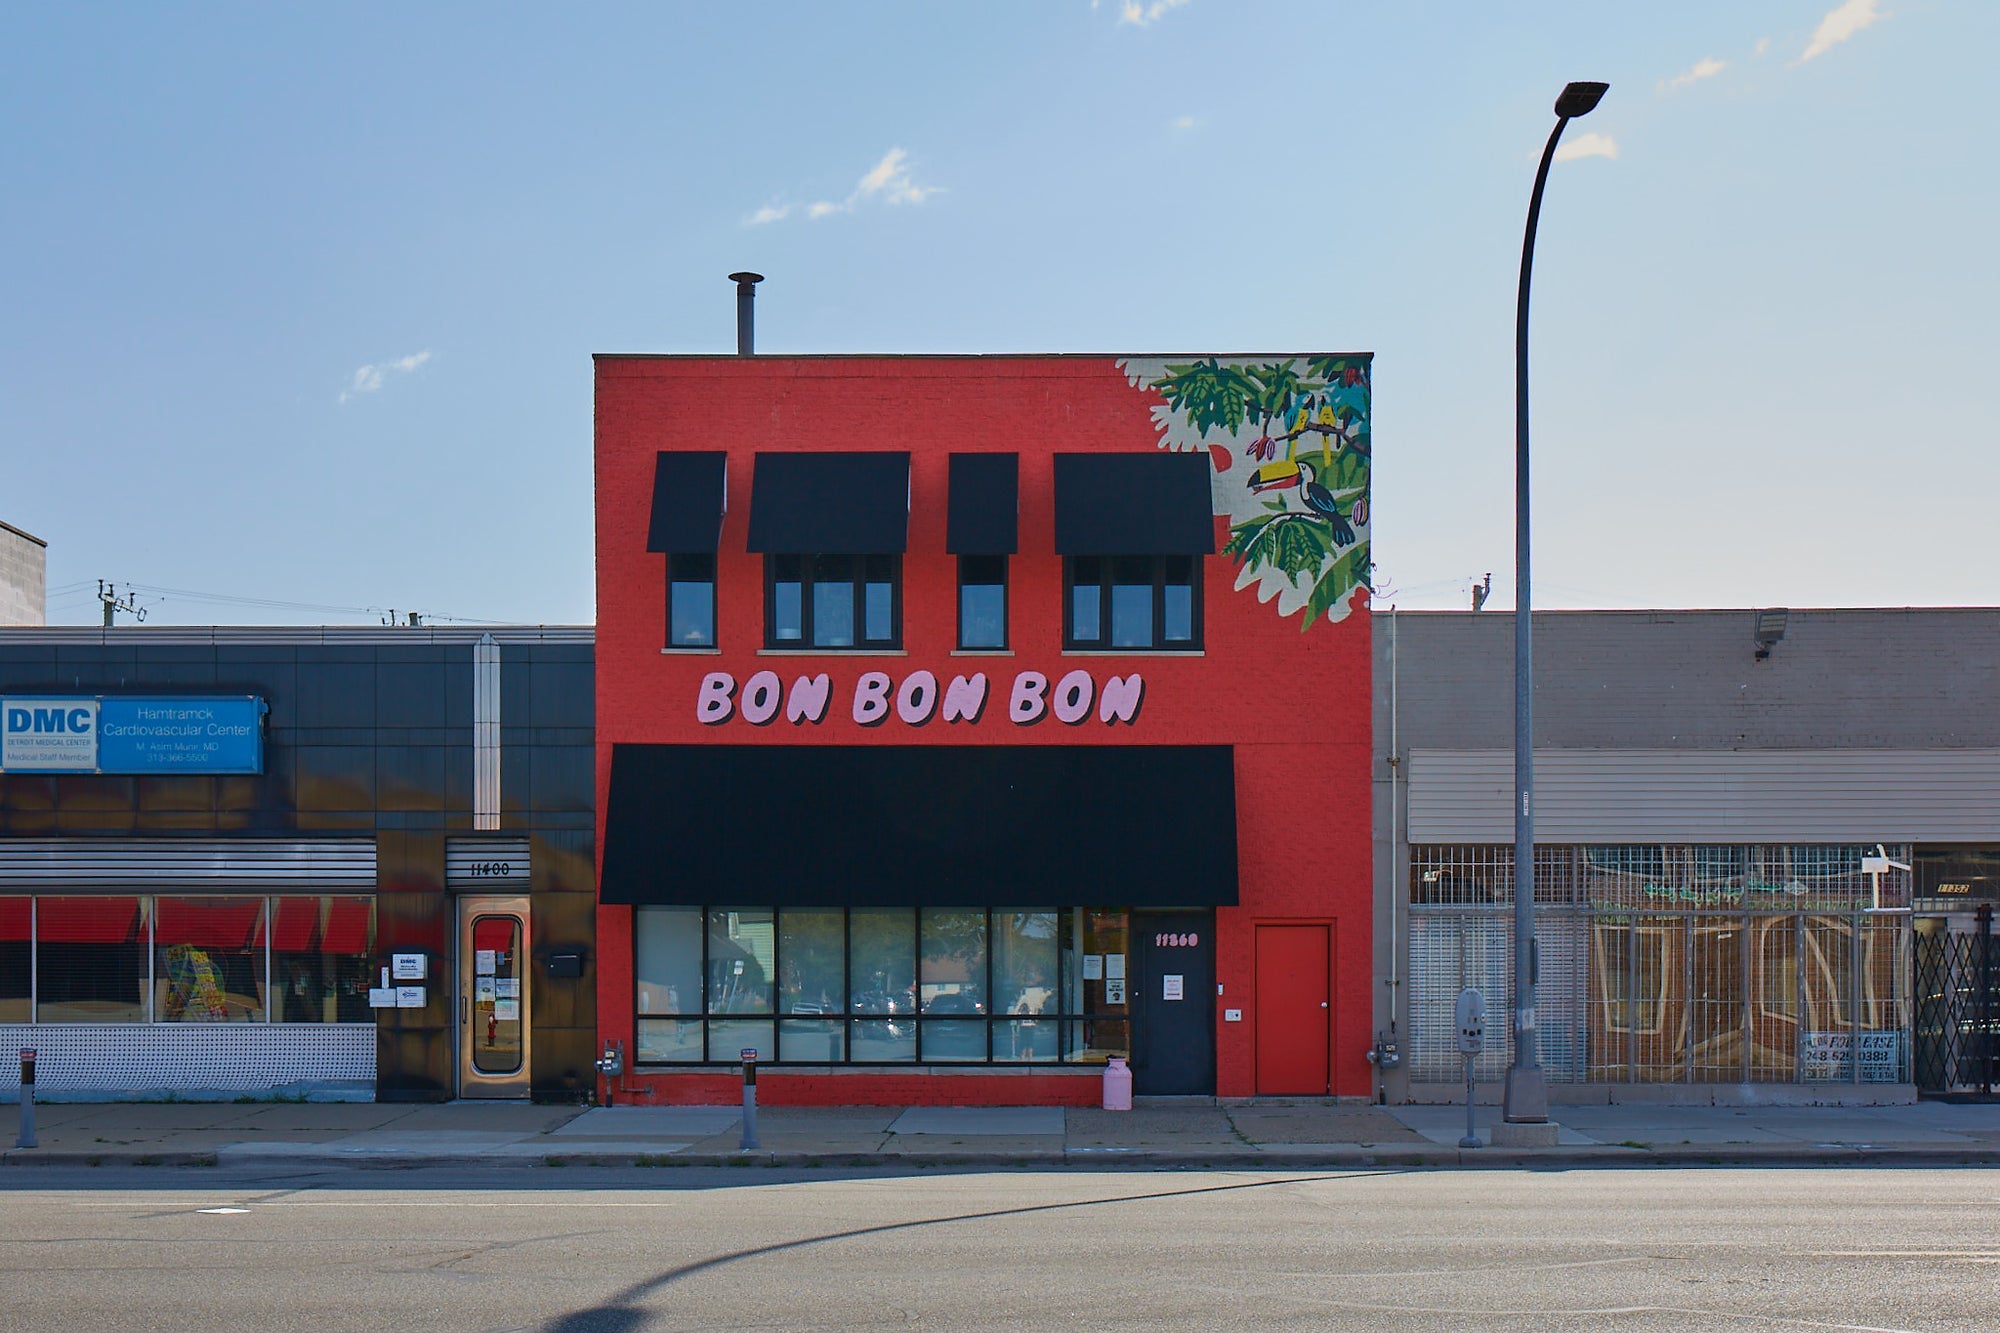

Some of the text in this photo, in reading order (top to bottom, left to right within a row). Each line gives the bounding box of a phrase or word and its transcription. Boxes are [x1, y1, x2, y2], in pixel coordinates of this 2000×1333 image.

[696, 669, 1146, 726] BON BON BON
[8, 708, 91, 733] DMC
[137, 707, 214, 720] Hamtramck
[103, 723, 251, 736] Cardiovascular Center
[8, 753, 91, 761] Medical Staff Member
[471, 862, 510, 876] 11400
[1155, 933, 1198, 947] 11360
